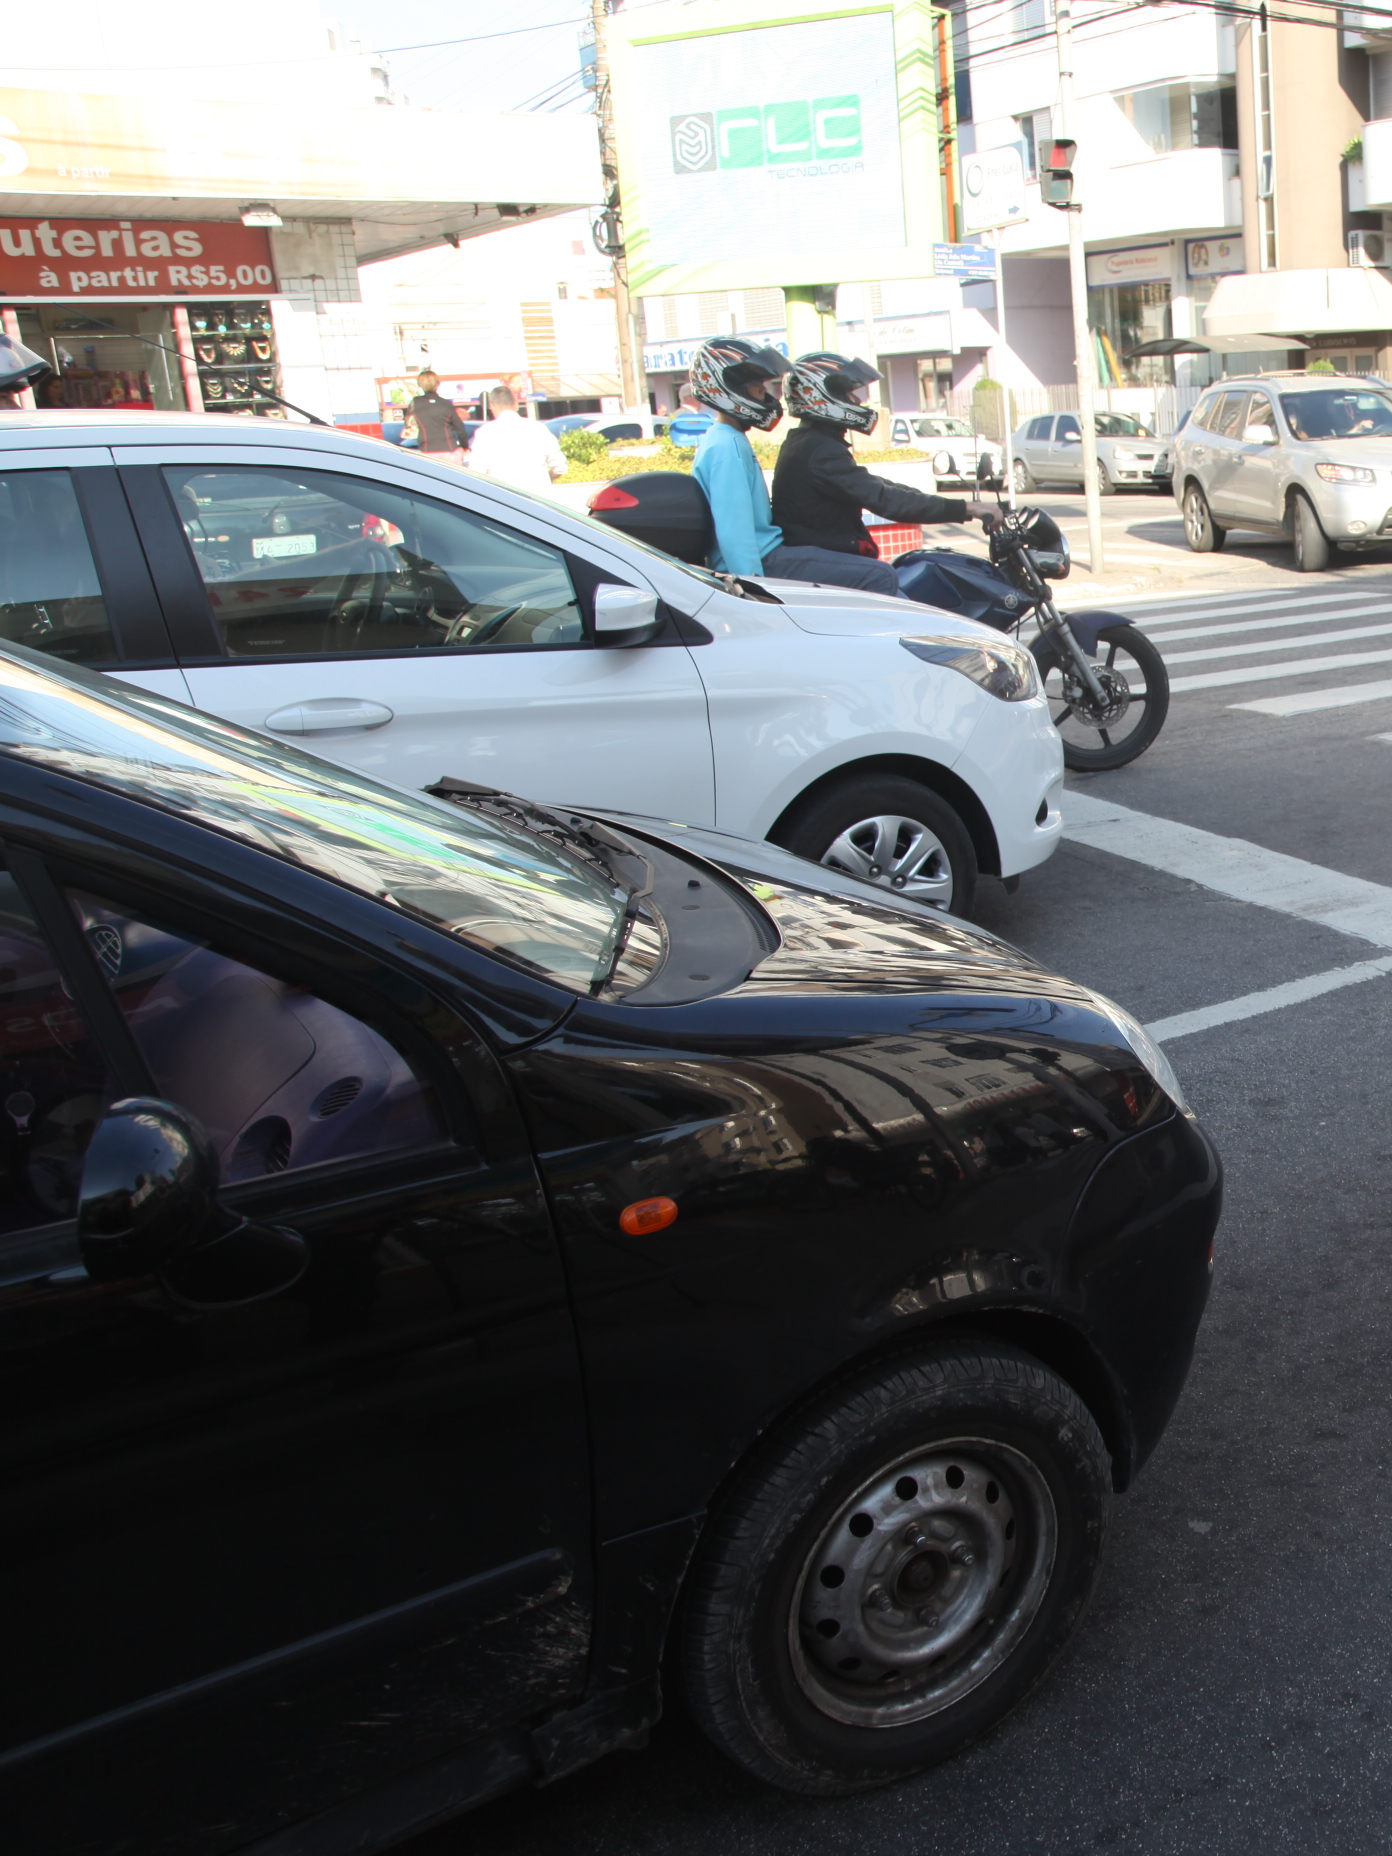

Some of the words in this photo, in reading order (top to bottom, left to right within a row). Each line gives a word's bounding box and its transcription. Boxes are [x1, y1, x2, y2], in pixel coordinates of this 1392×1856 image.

[767, 161, 866, 180] TECNOLOGIA
[39, 266, 60, 287] à
[69, 266, 159, 292] partir
[168, 265, 272, 290] R$5,00
[287, 541, 315, 554] 2053
